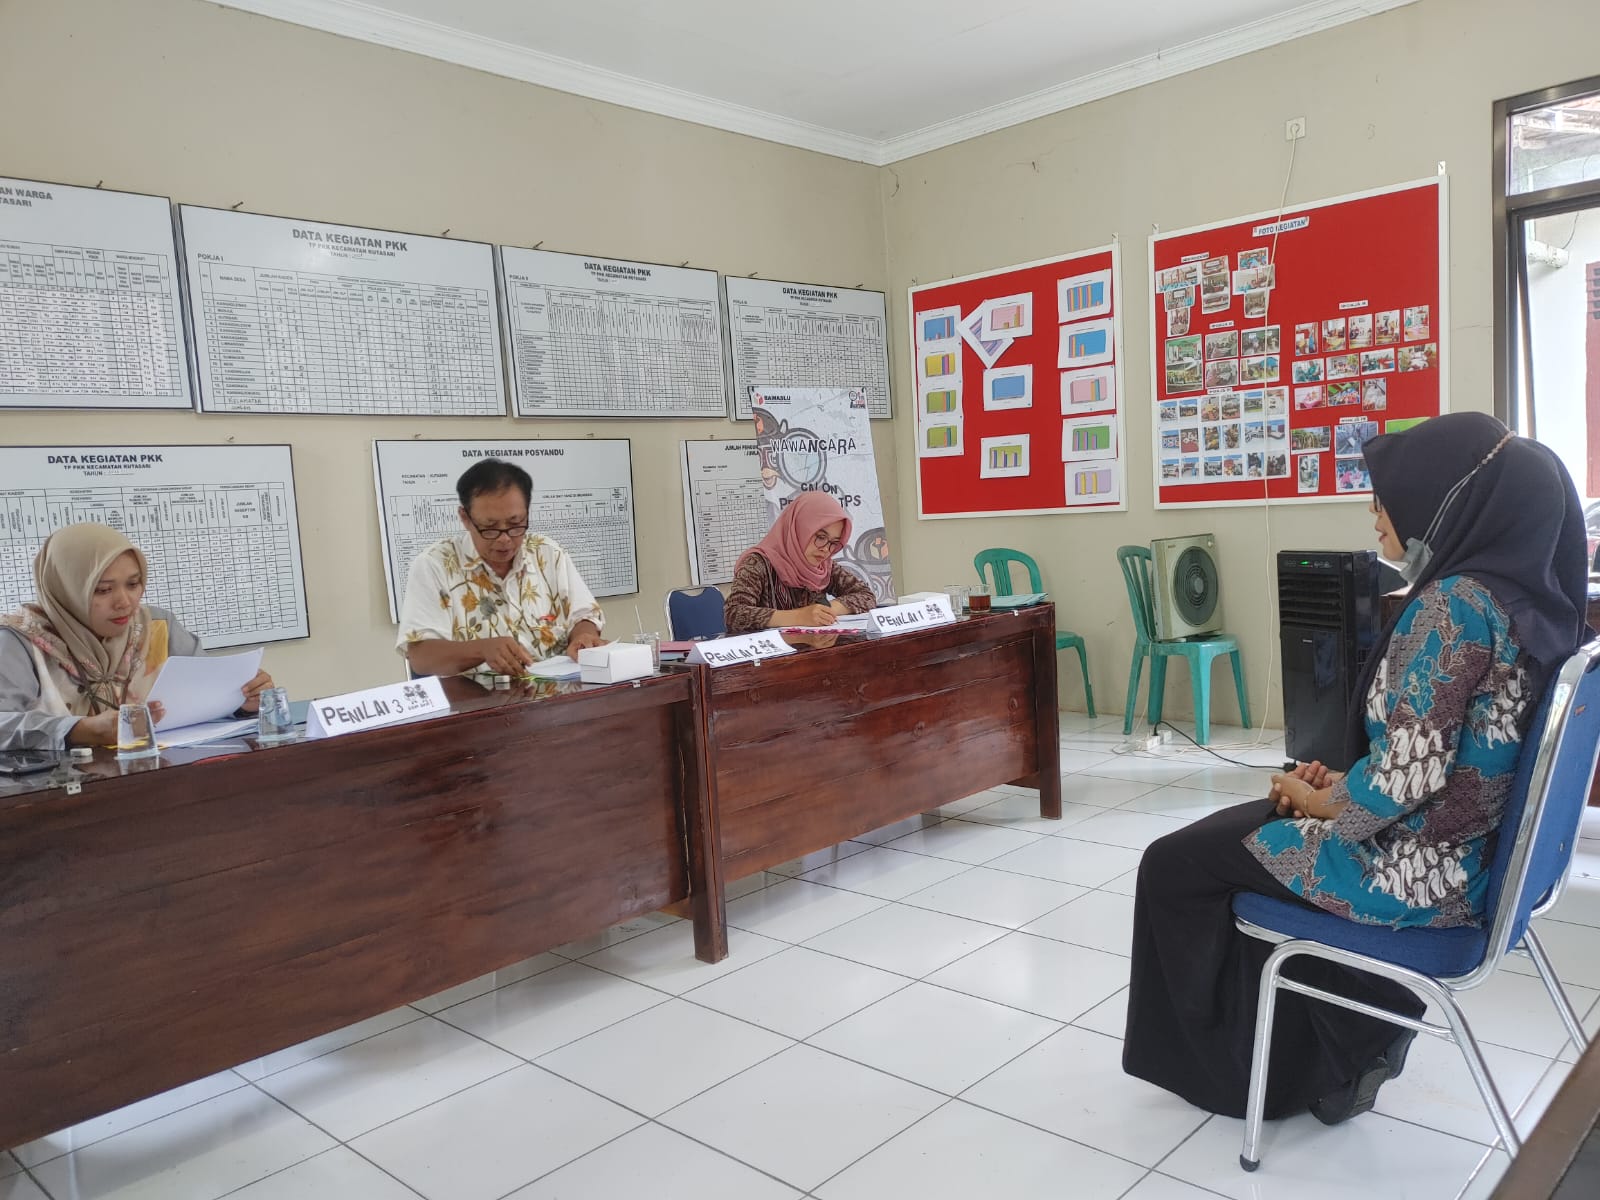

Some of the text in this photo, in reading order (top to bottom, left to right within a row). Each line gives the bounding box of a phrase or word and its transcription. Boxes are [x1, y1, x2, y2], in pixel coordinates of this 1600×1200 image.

[16, 188, 53, 200] WARGA
[1258, 226, 1274, 235] FOTO
[292, 228, 408, 252] DATA KEGIATAN PKK
[332, 245, 366, 254] KECAMATAN
[197, 253, 220, 261] POKJA
[584, 262, 652, 276] DATA KEGIATAN PKK
[798, 288, 826, 298] KEGIATAN
[772, 438, 856, 454] WAWANCARA
[48, 454, 164, 464] DATA KEGIATAN PKK
[462, 448, 564, 458] DATA KEGIATAN POSYANDU
[838, 494, 862, 508] TPS
[877, 612, 918, 627] PENILAI
[704, 644, 762, 664] PENILAI 2
[322, 700, 390, 726] PENILAI
[392, 699, 404, 714] 3
